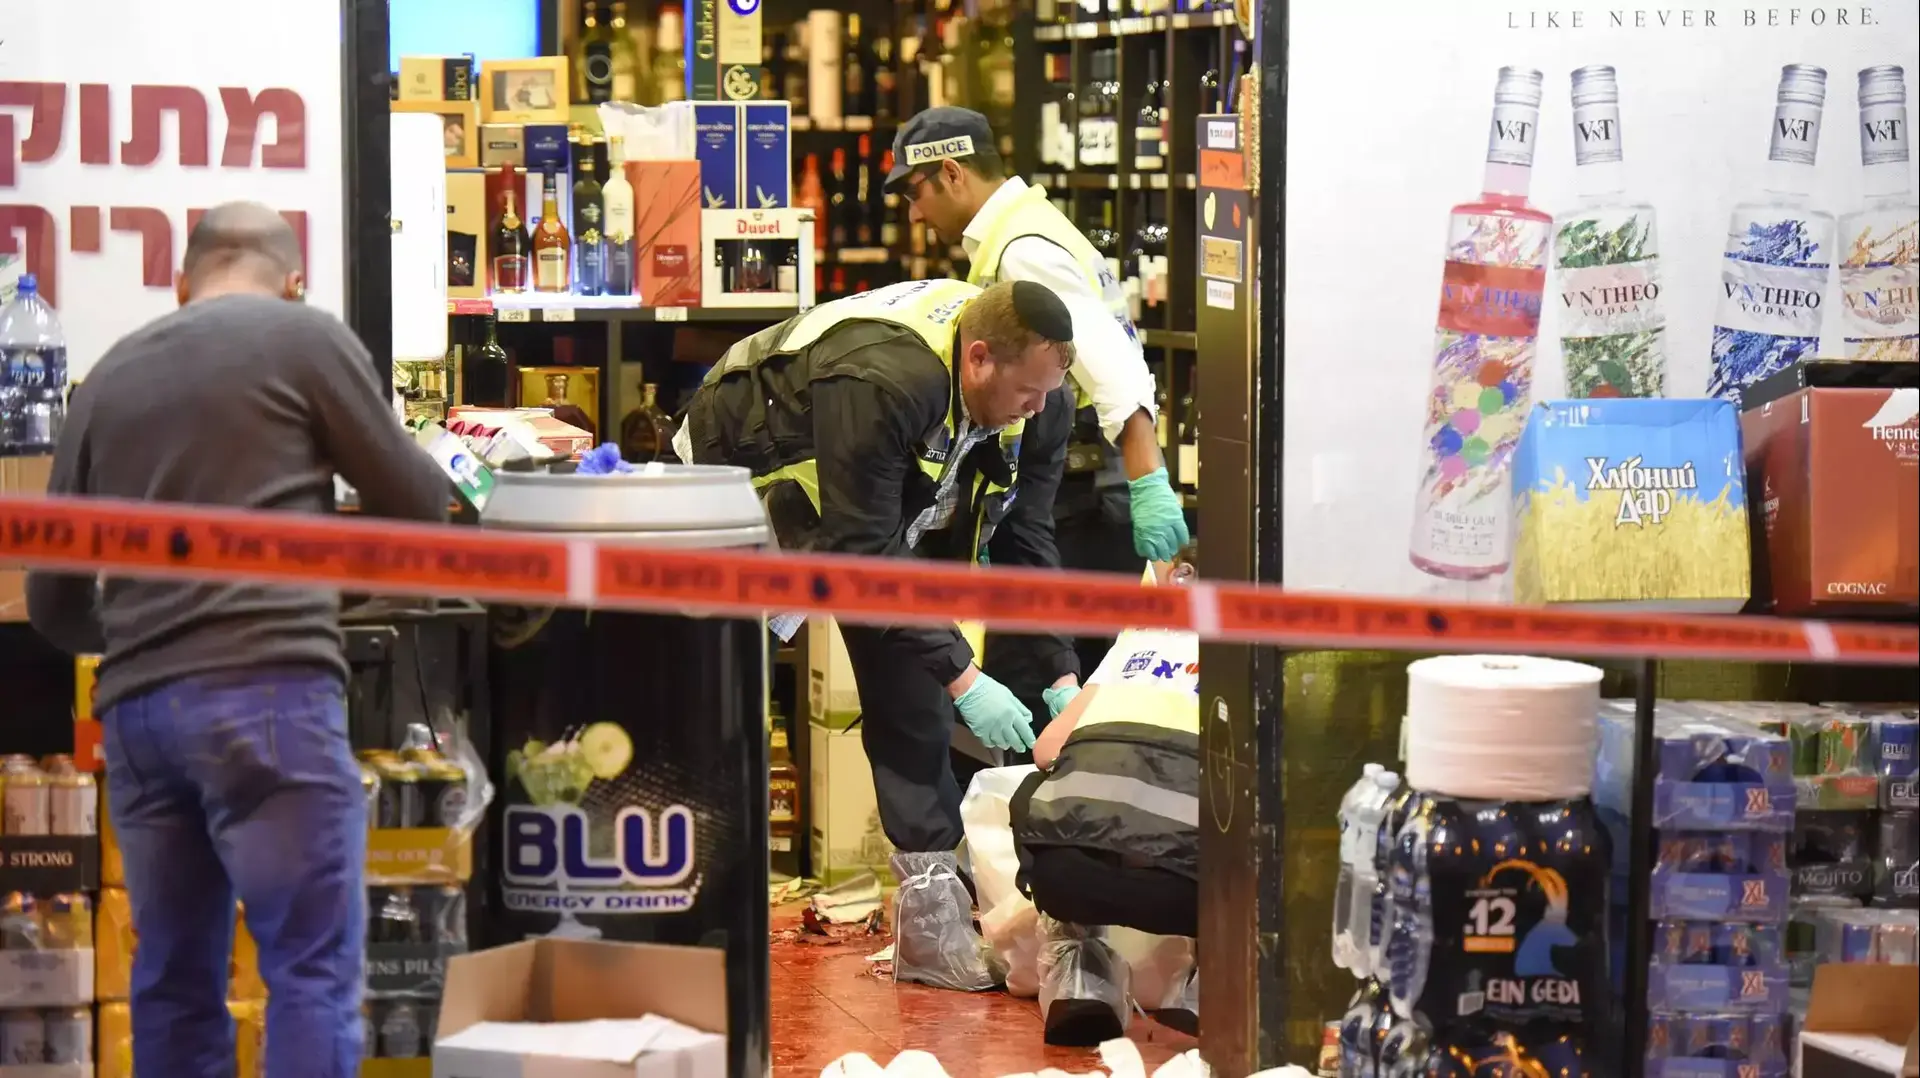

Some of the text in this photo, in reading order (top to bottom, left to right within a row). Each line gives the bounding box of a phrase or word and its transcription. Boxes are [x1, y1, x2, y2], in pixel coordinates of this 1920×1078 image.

[1507, 7, 1880, 29] LIKE NEVER BEFORE.
[0, 81, 306, 186] מתוק
[913, 140, 969, 159] POLICE
[737, 219, 780, 234] Duvel
[0, 204, 307, 310] ריף
[1583, 304, 1640, 317] VODKA
[1741, 303, 1797, 318] VODKA
[1584, 453, 1698, 490] Хлібний
[1615, 486, 1671, 531] Дар
[1827, 582, 1887, 596] COGNAC
[1746, 788, 1773, 815] XL
[504, 805, 694, 886] BLU
[10, 851, 74, 866] STRONG
[1797, 869, 1863, 888] MOJITO
[507, 893, 689, 909] ENERGY DRINK
[1741, 880, 1770, 906] XL
[403, 958, 444, 976] PILS
[1486, 978, 1581, 1005] EIN GEDI
[1740, 971, 1769, 997] XL
